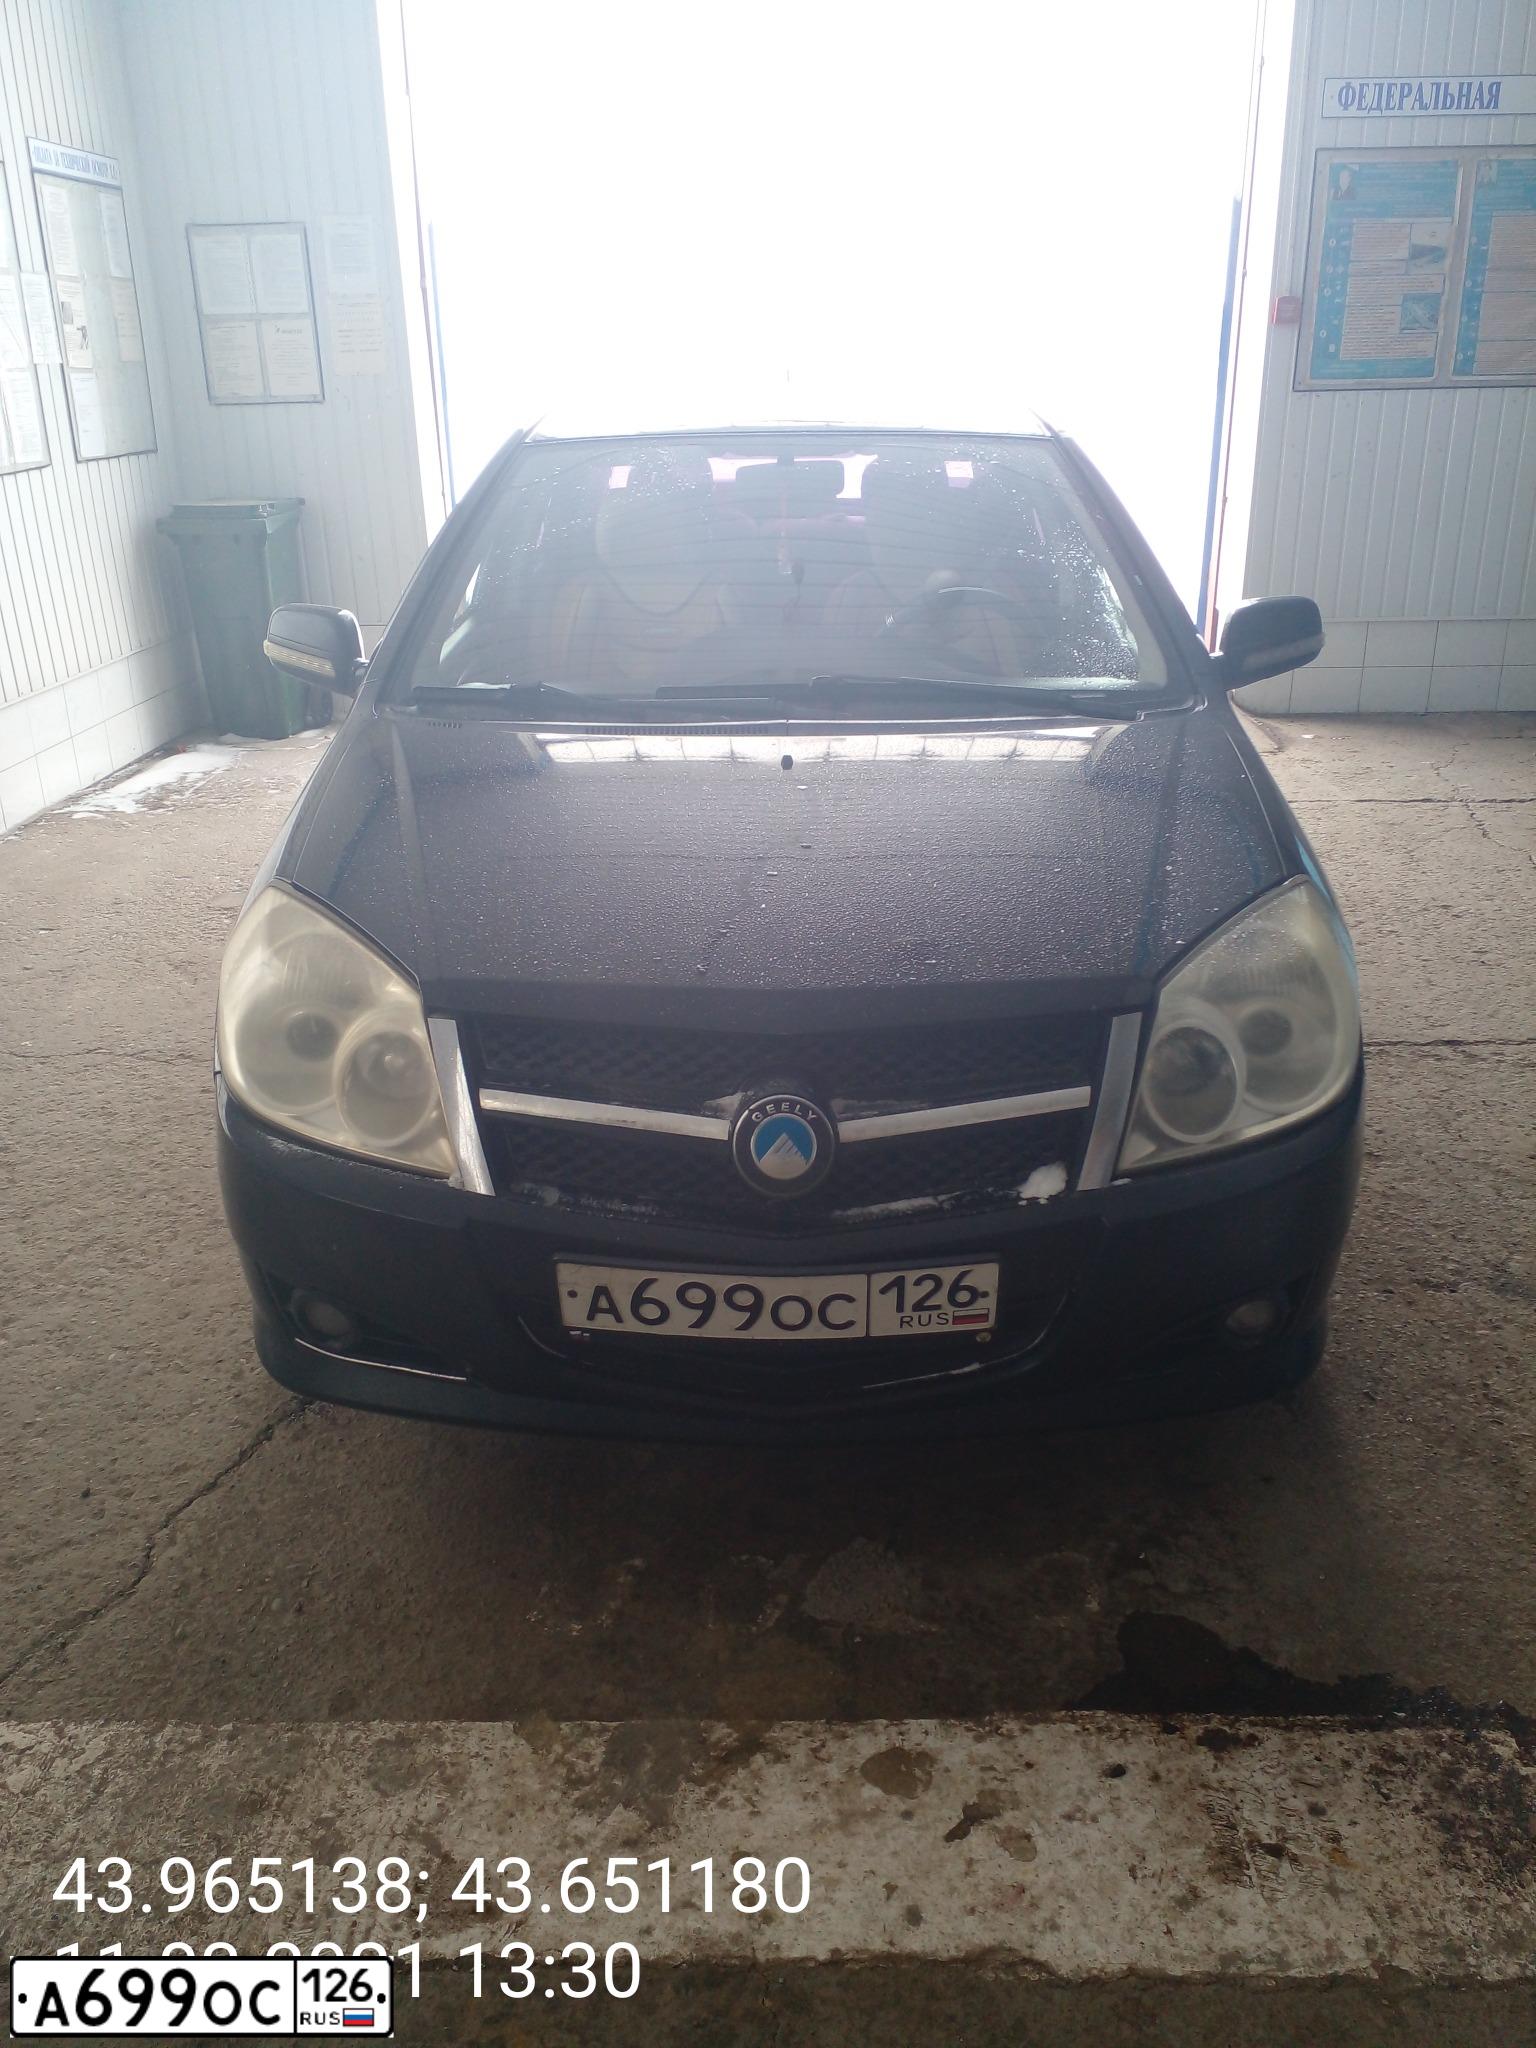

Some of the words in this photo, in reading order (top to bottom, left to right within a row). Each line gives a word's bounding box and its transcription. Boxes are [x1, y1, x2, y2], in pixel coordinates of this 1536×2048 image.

[1337, 81, 1502, 115] ФЕДЕРАЛЬНАЯ
[751, 1102, 817, 1122] GEELY
[878, 1269, 978, 1314] 126
[900, 1311, 950, 1329] RUS
